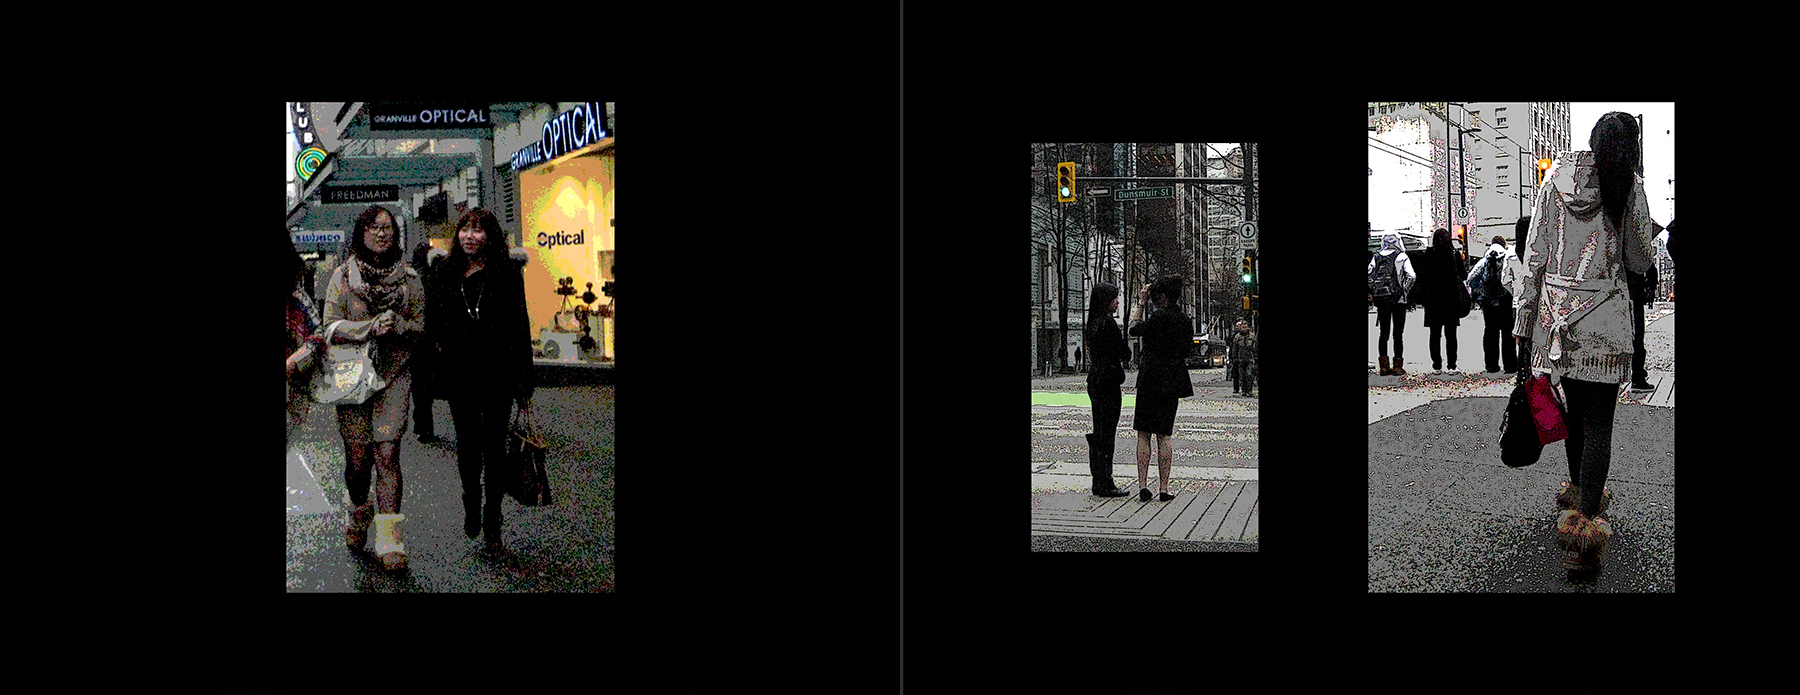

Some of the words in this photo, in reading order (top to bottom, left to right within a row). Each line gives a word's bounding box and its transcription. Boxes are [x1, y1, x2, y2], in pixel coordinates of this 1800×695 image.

[374, 114, 417, 123] GRANVILLE
[420, 109, 487, 123] OPTICAL
[511, 141, 541, 170] GRANVILLE
[542, 102, 606, 159] OPTICAL
[331, 190, 389, 200] FREEDMAN
[1118, 190, 1158, 198] Dunsmuir
[1160, 188, 1169, 196] St
[537, 229, 585, 249] Optical
